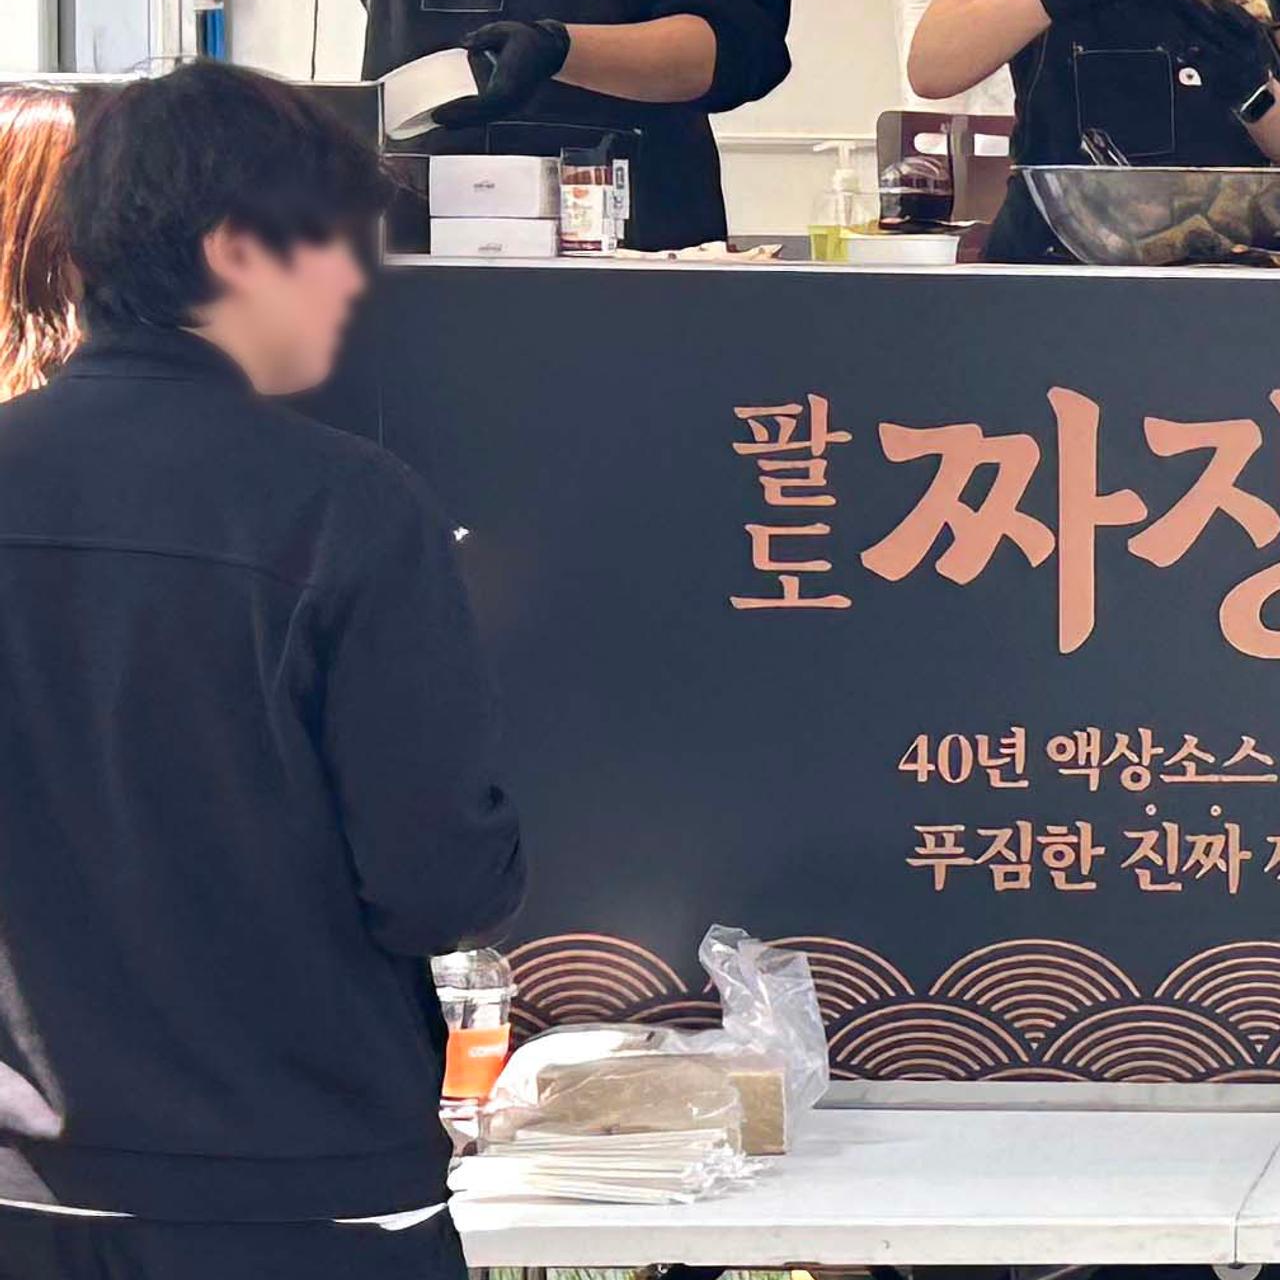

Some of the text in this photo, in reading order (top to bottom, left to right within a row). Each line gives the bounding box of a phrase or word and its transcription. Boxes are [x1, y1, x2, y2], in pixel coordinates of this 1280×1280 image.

[730, 393, 853, 609] 팔도
[898, 726, 1029, 789] 40년
[1046, 726, 1278, 792] 액상소스
[905, 820, 1105, 892] 푸짐한
[1120, 821, 1252, 895] 진짜
